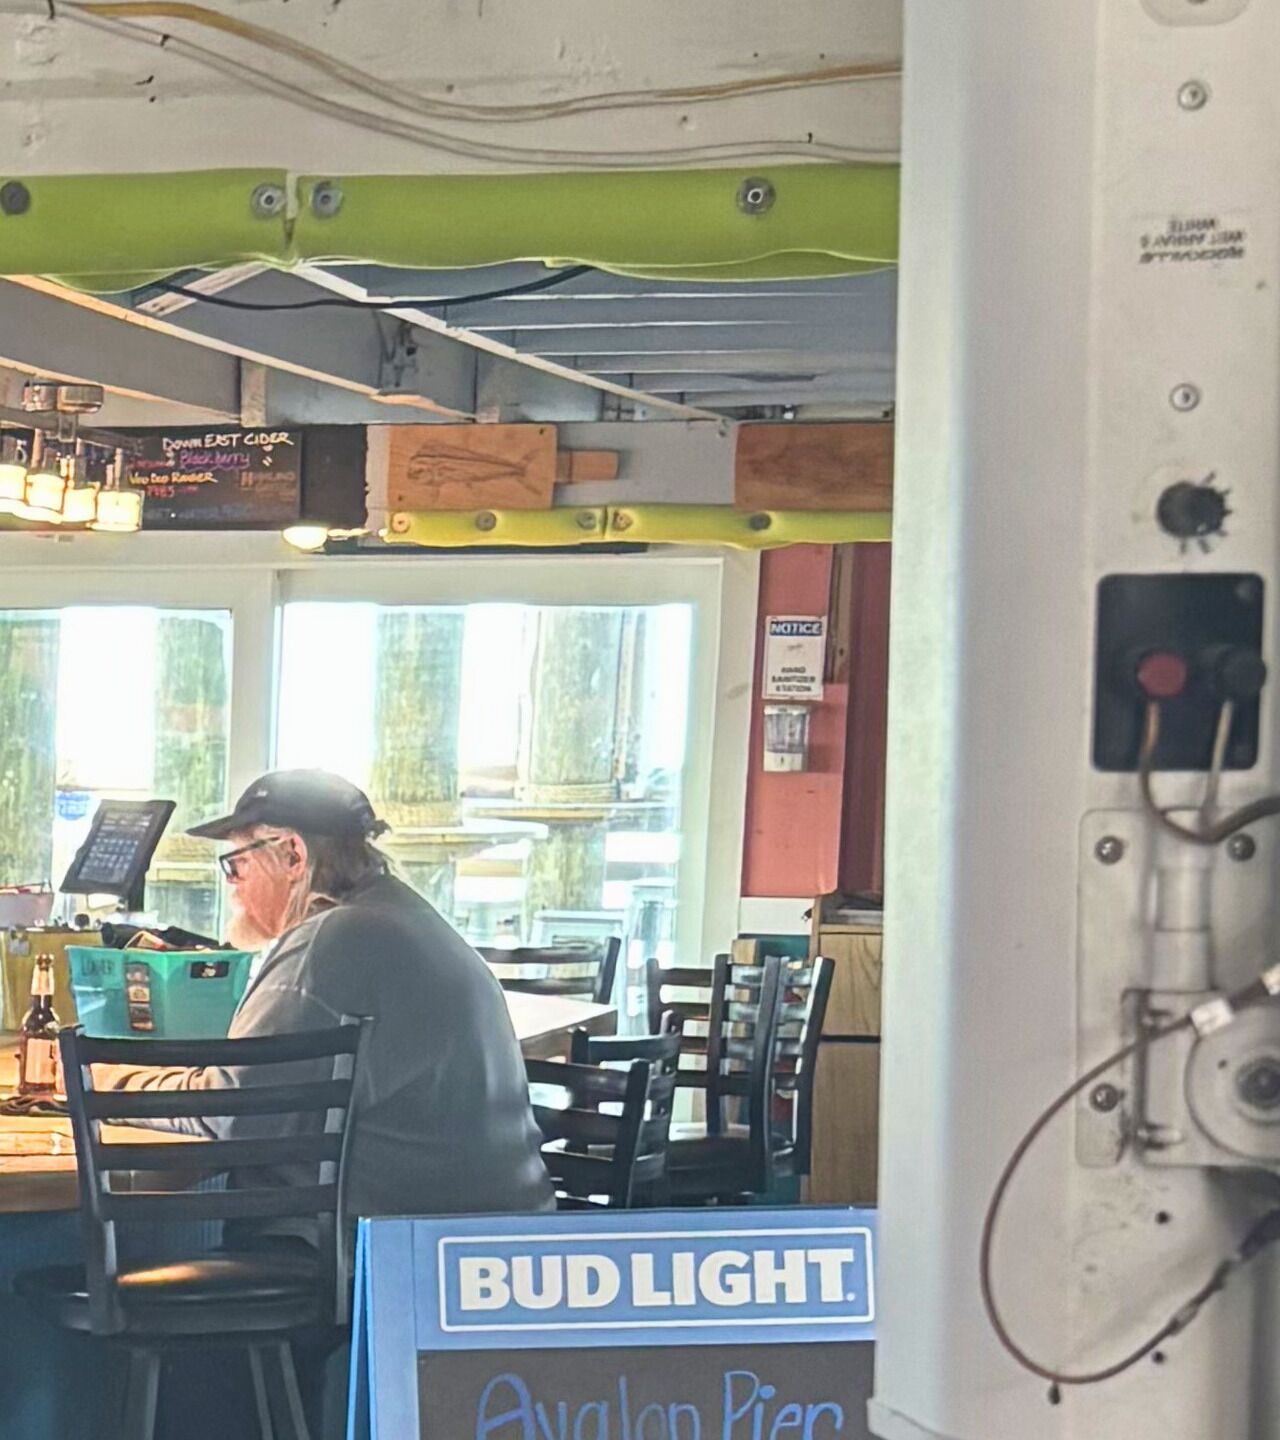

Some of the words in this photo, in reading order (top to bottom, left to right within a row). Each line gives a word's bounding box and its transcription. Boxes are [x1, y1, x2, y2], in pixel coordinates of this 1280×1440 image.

[770, 623, 822, 634] NOTICE
[459, 1254, 621, 1311] BUD
[630, 1248, 856, 1306] LIGHT
